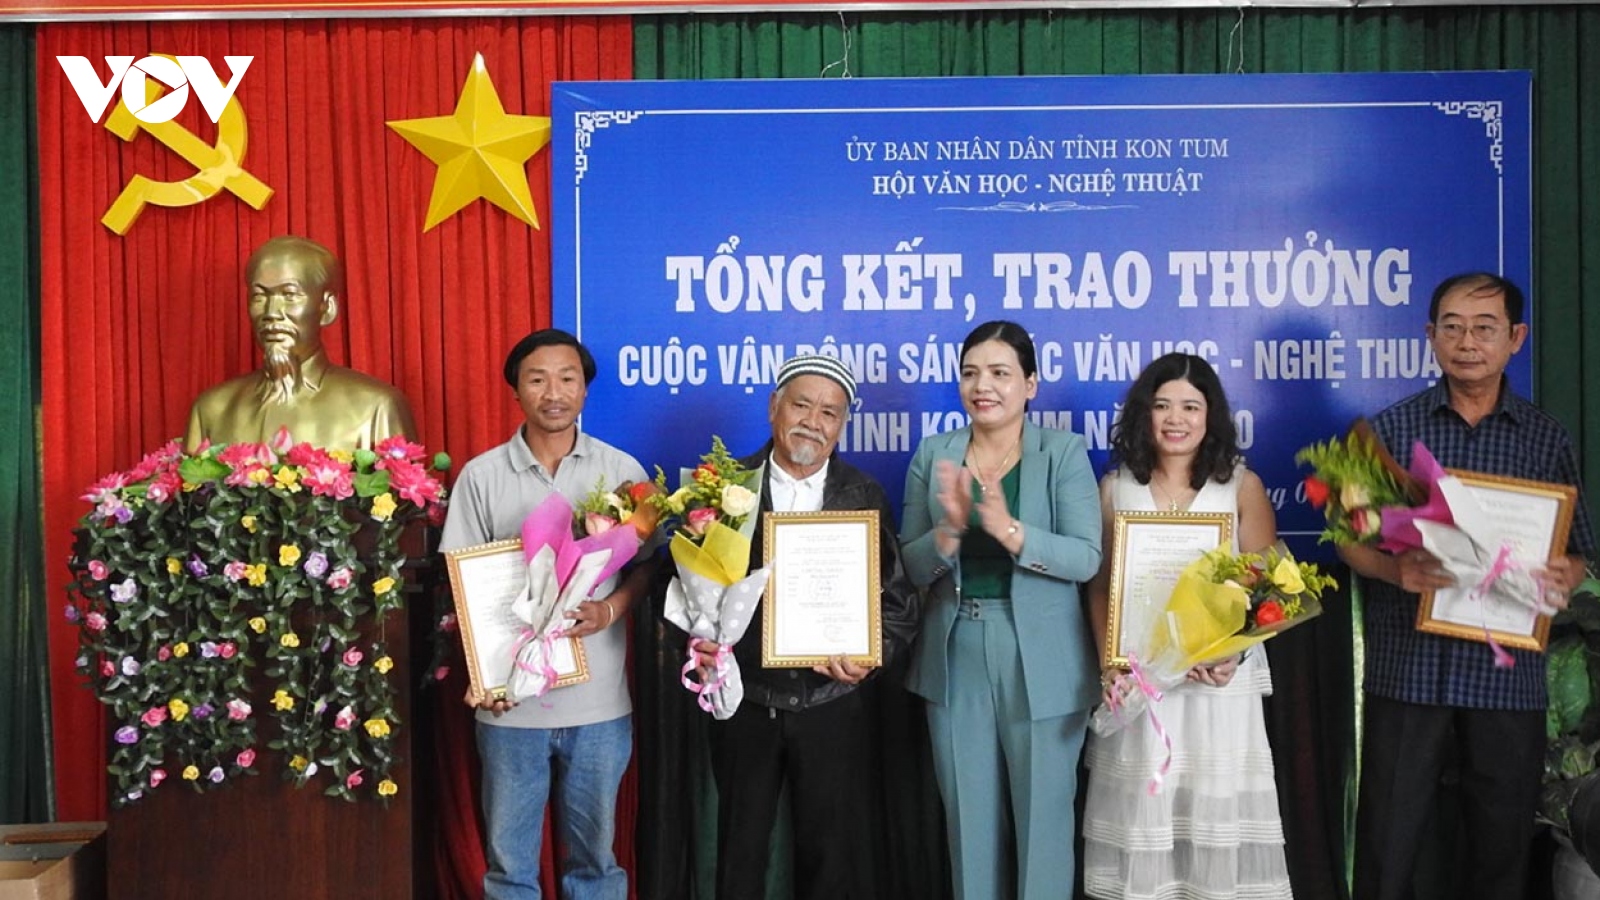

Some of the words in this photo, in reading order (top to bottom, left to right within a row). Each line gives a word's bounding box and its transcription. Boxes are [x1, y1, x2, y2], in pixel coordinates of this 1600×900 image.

[847, 136, 877, 162] ỦY
[884, 141, 928, 161] BAN
[937, 136, 1000, 161] NHÂN
[1009, 135, 1055, 160] DÂN
[1062, 134, 1118, 159] TỈNH
[1126, 139, 1173, 159] KON
[1180, 138, 1229, 158] TUM
[873, 170, 916, 198] HỘI
[923, 170, 970, 194] VĂN
[979, 174, 1027, 198] HỌC
[1048, 167, 1116, 197] NGHỆ
[1123, 167, 1203, 197] THUẬT
[666, 235, 825, 313] TỔNG
[843, 236, 976, 322] KẾT,
[993, 250, 1152, 310] TRAO
[1168, 230, 1412, 310] THƯỞNG
[619, 336, 707, 394] CUỘC
[717, 336, 783, 394] VẬN
[795, 335, 888, 384] NG
[898, 333, 964, 384] SÁN
[1073, 332, 1141, 382] VĂN
[1229, 358, 1244, 368] -
[1254, 330, 1346, 388] NGHỆ
[1356, 336, 1443, 388] THUẬ
